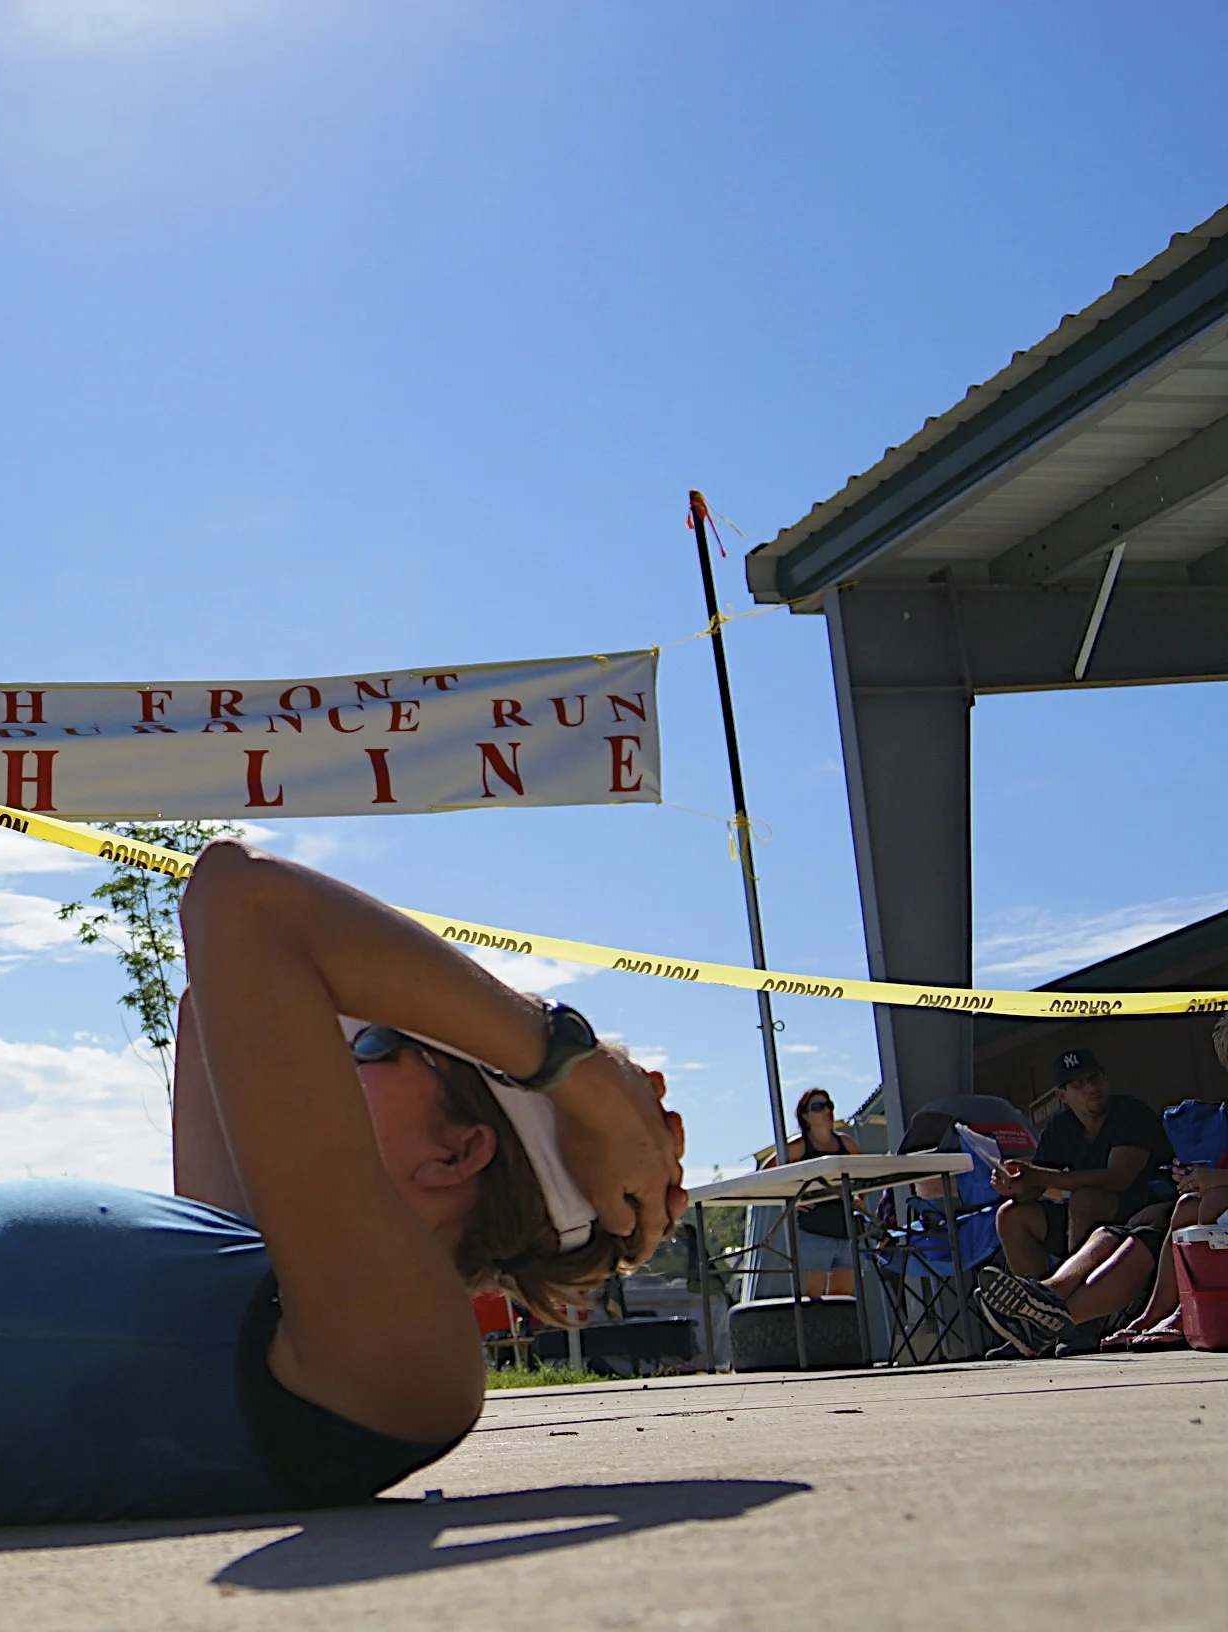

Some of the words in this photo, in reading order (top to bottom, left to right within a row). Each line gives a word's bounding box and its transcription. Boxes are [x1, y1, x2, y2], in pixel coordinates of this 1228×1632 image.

[136, 673, 460, 723] FRONT
[491, 692, 648, 728] RUN
[243, 735, 644, 808] LINE
